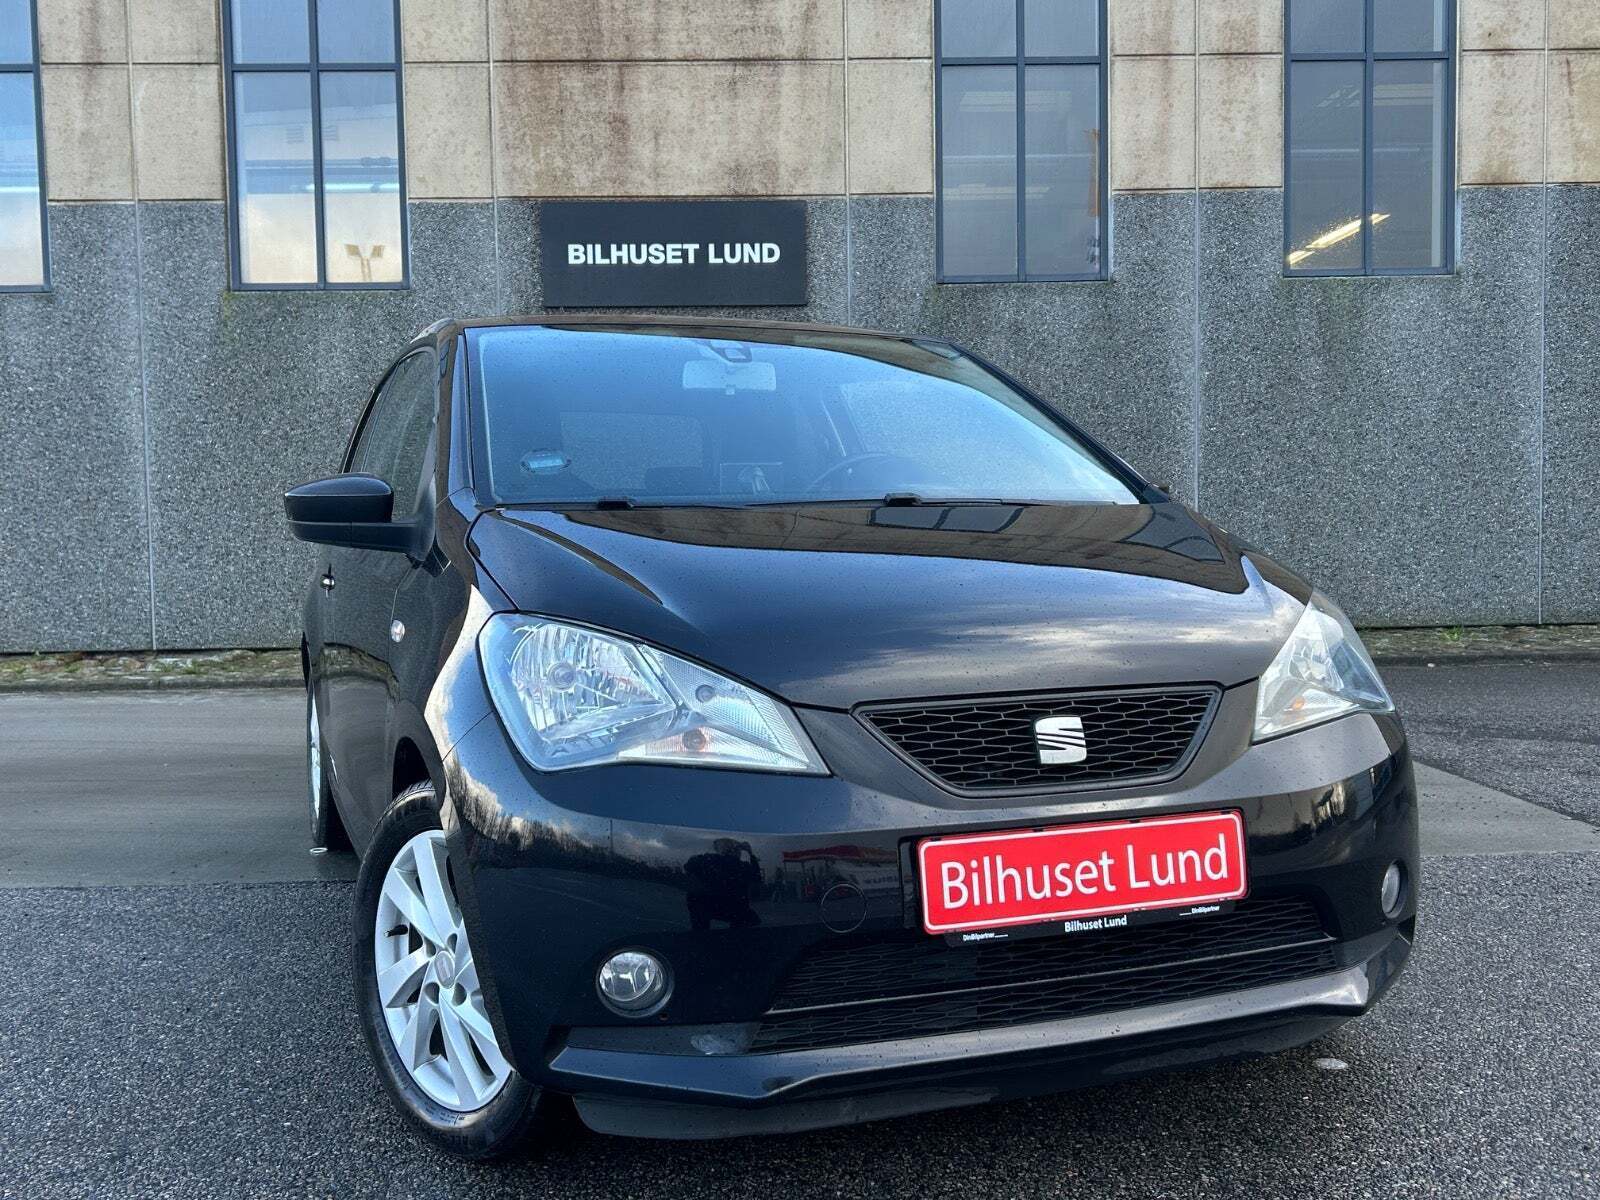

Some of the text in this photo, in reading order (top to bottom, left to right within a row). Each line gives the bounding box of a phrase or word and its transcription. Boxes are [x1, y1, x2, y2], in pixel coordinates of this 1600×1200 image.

[567, 243, 781, 265] BILHUSET LUND
[940, 832, 1229, 910] Bilhuset Lund
[1064, 915, 1128, 933] Bilhuset Lund
